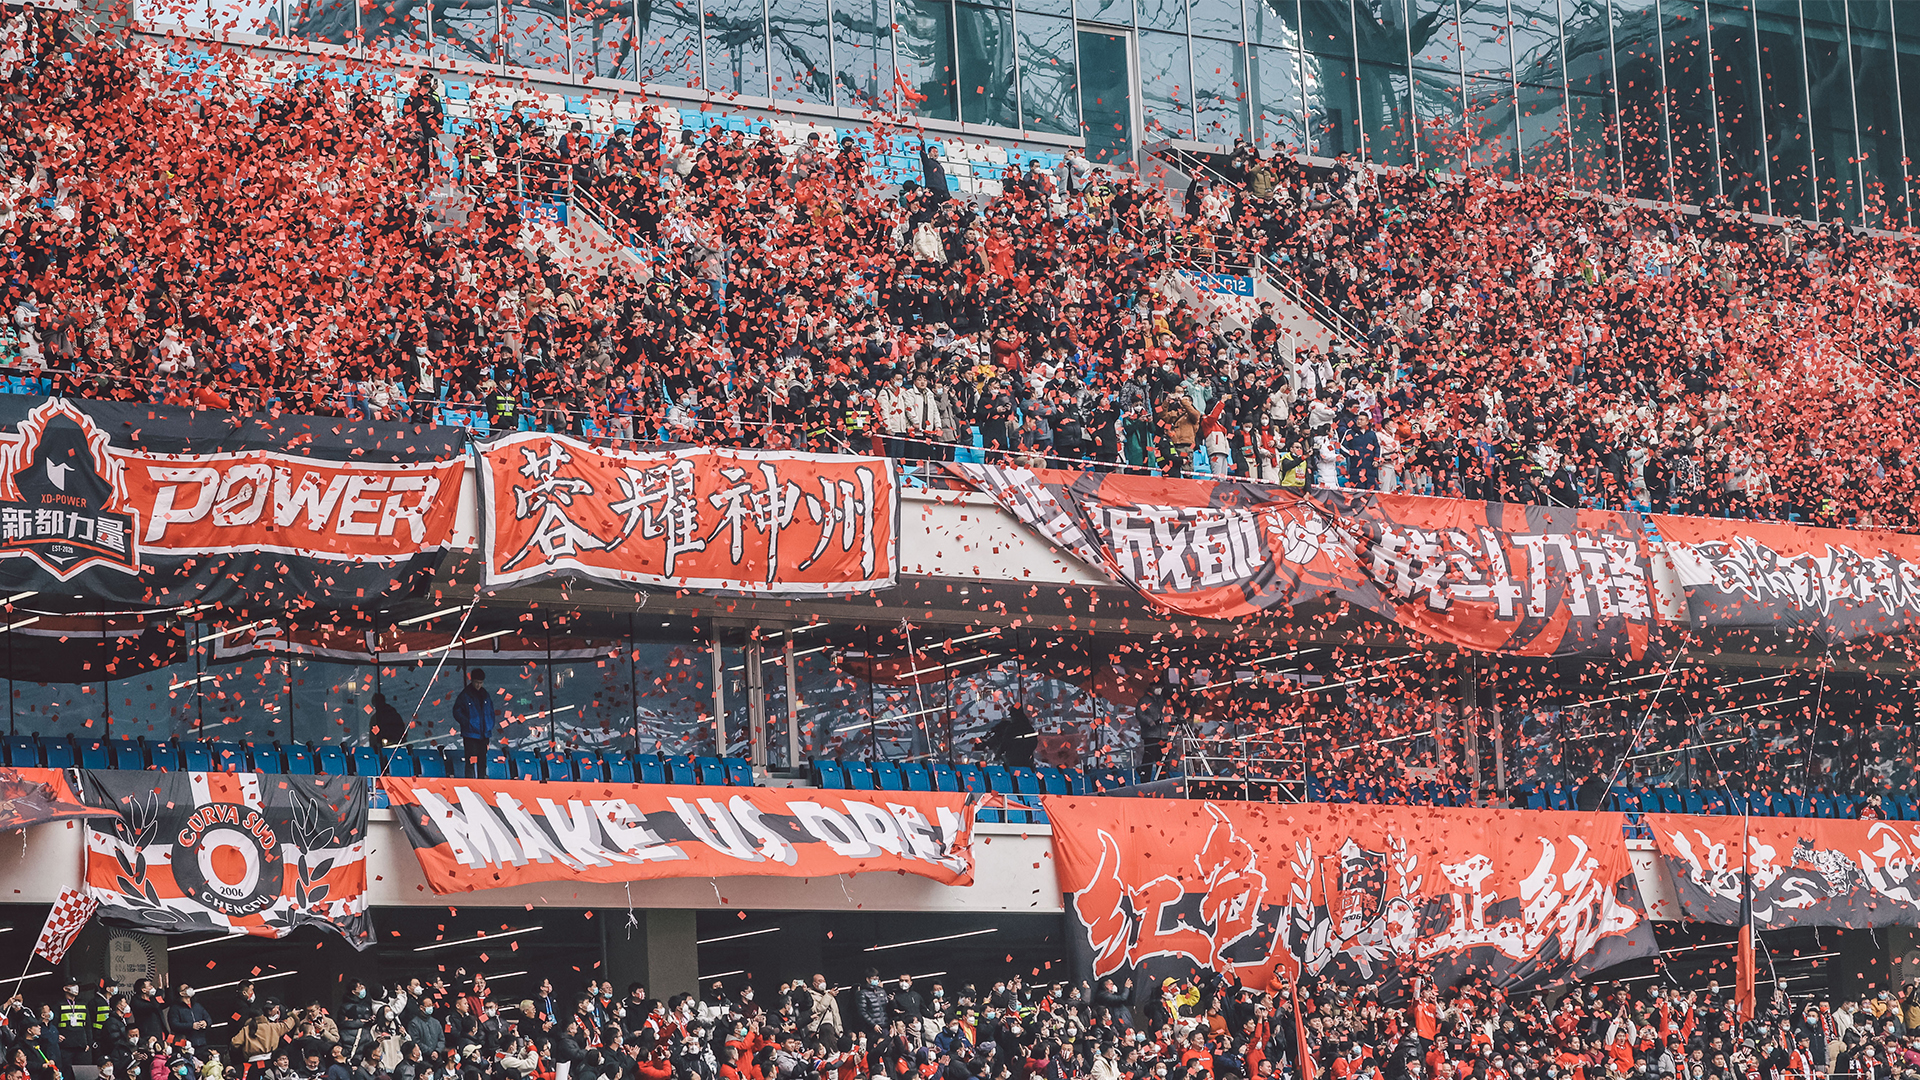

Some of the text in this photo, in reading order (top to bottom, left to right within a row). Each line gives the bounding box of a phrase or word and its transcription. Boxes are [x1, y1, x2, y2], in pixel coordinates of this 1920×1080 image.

[41, 493, 87, 508] XD-POWER
[144, 463, 441, 544] POWER
[500, 445, 876, 583] 蓉耀神州
[1, 507, 126, 553] 新都力量
[178, 805, 277, 851] CURVA SUD
[412, 786, 689, 870] MAKE
[667, 794, 797, 865] US
[201, 891, 270, 915] CHENGDU
[219, 886, 244, 897] 2006
[1073, 801, 1302, 993] 红色
